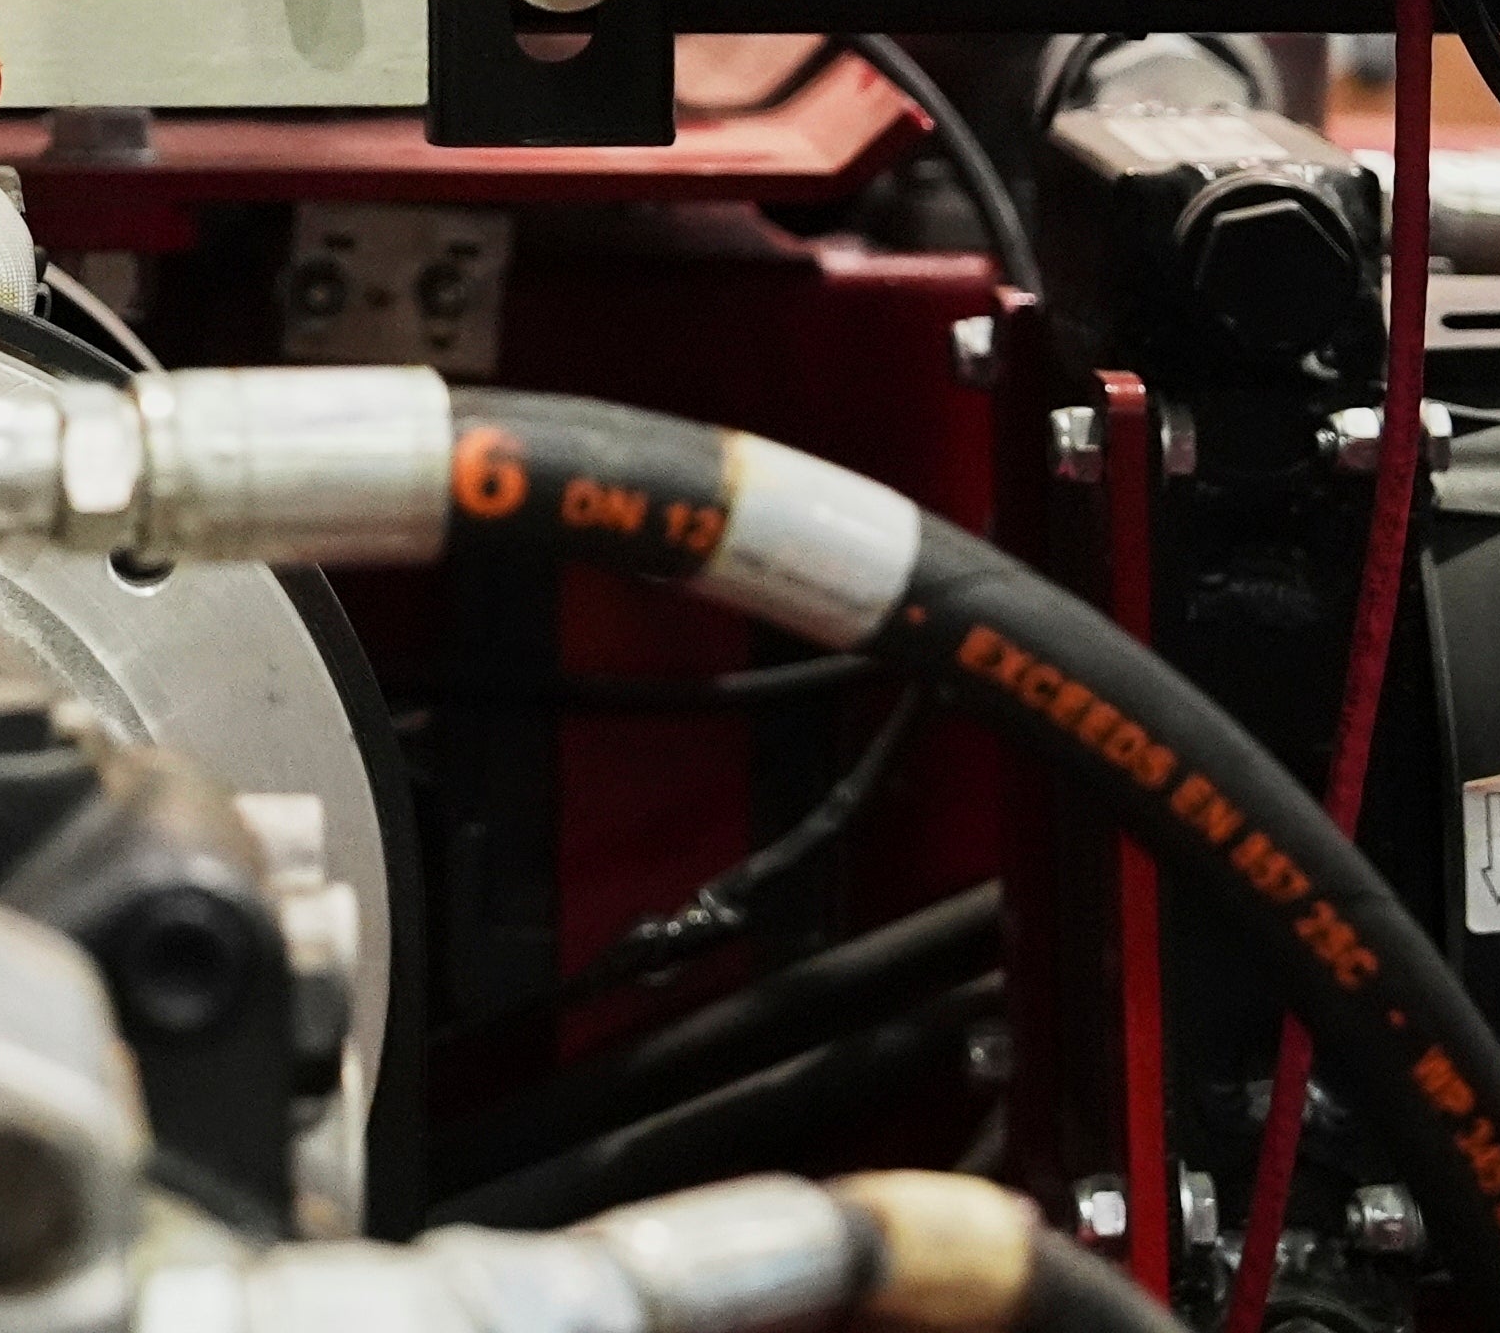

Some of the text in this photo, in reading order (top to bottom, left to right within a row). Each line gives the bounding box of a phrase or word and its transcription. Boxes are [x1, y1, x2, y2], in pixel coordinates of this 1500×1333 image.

[561, 479, 645, 533] DN
[957, 625, 1177, 789] EXCEEDS
[1169, 774, 1243, 846] EN
[1295, 900, 1379, 987] 2SC
[1412, 1046, 1475, 1117] WP
